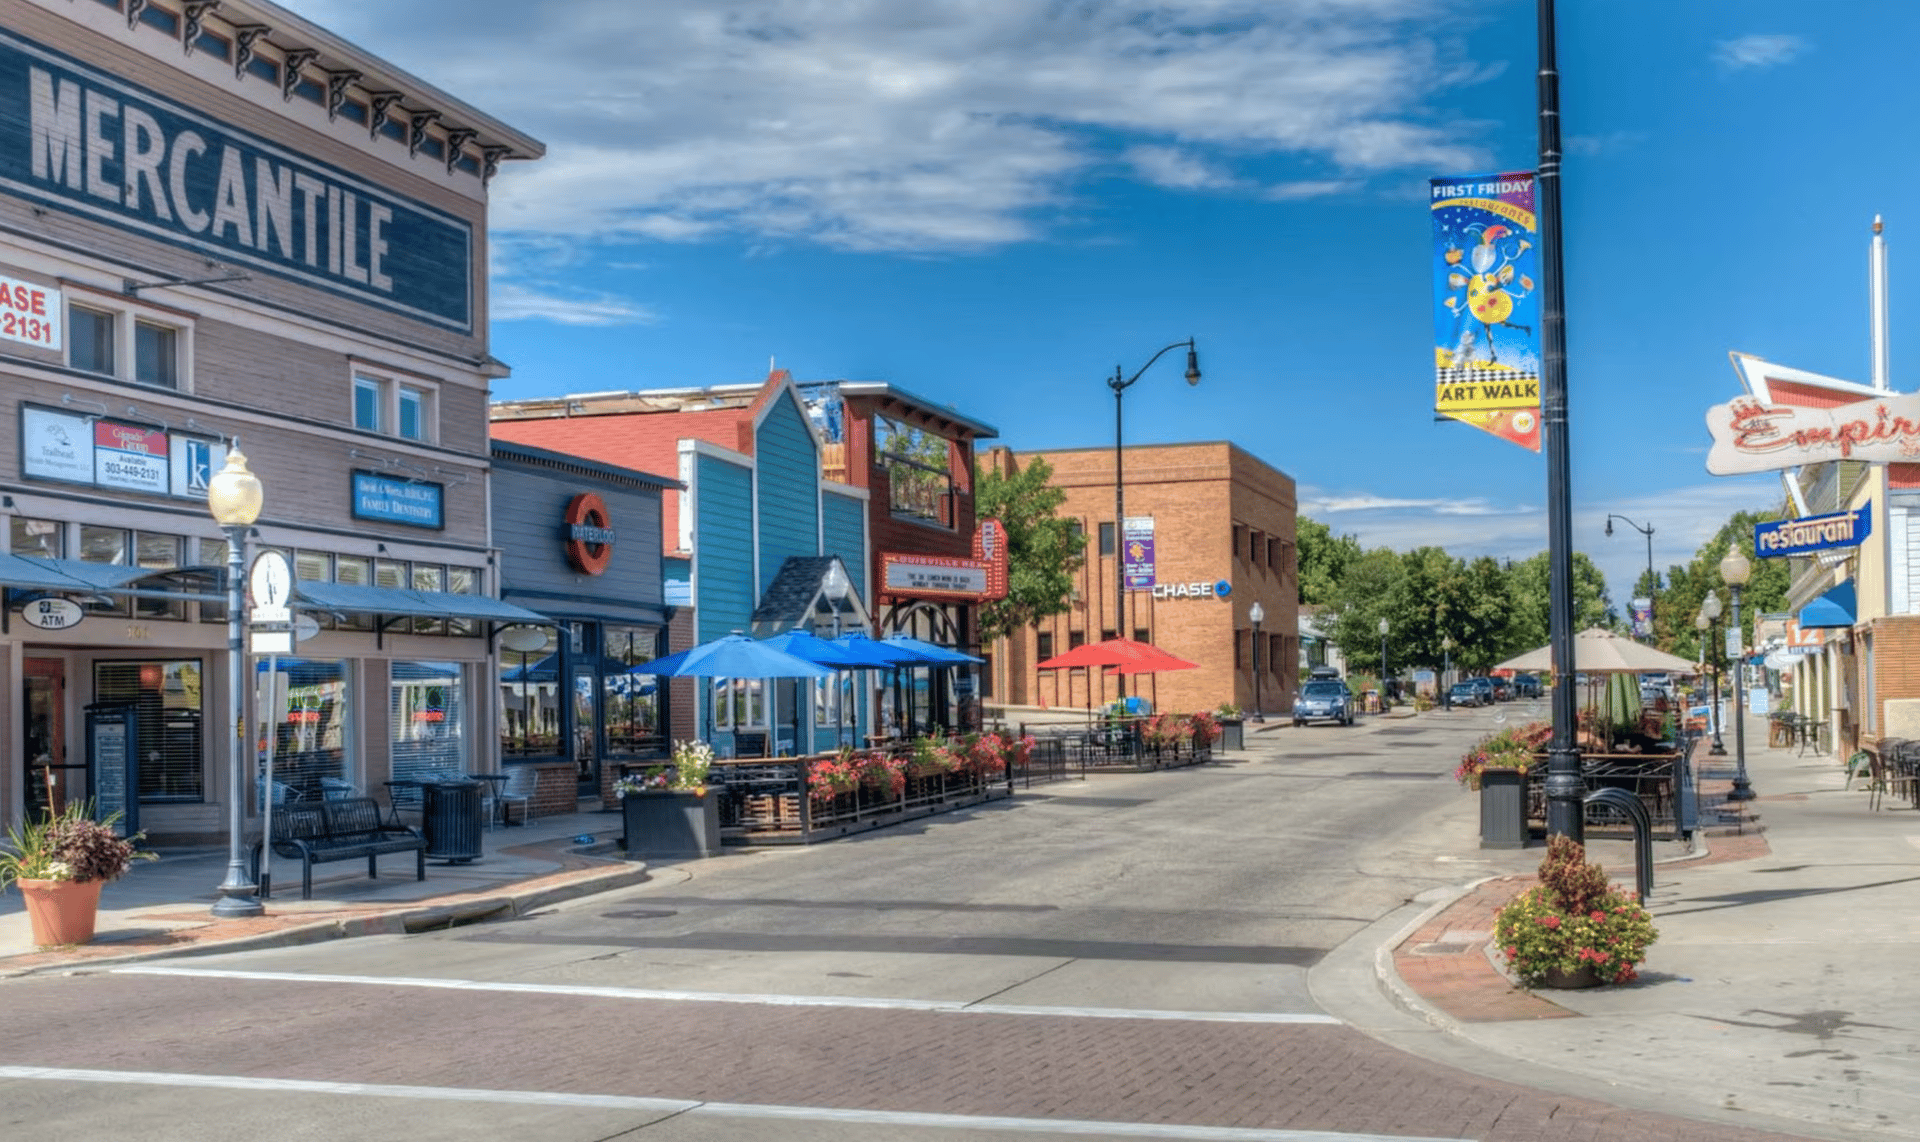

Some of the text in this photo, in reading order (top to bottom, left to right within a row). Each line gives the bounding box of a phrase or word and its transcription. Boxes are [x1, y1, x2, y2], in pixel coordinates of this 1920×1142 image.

[30, 65, 393, 293] MERCANTILE
[1433, 179, 1533, 198] FIRST FRIDAY
[0, 312, 51, 343] 2131
[1440, 384, 1537, 401] ART WALK
[1729, 402, 1920, 457] Empir
[105, 462, 160, 480] 303-449-2131
[572, 525, 615, 544] WATERLOO
[982, 521, 995, 561] REX
[1759, 513, 1859, 551] restaurant
[1152, 582, 1211, 597] CHASE
[40, 615, 65, 627] ATM
